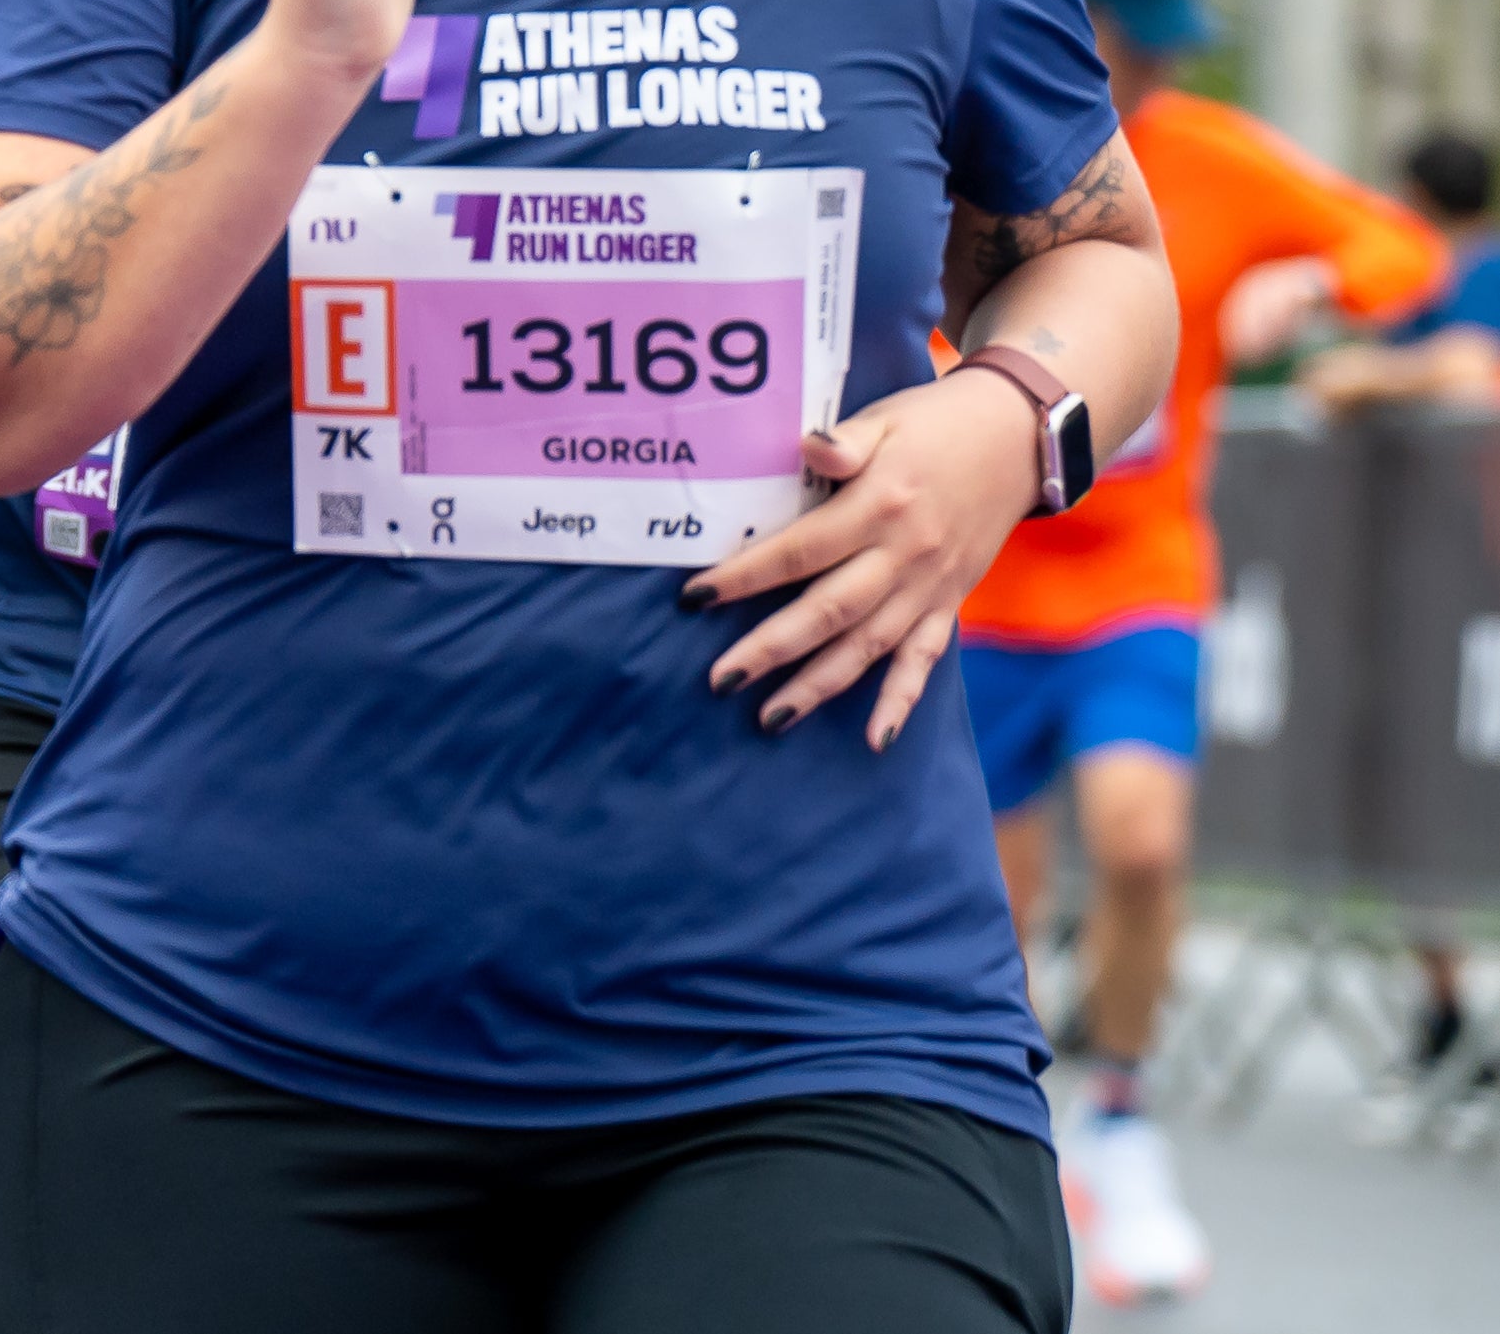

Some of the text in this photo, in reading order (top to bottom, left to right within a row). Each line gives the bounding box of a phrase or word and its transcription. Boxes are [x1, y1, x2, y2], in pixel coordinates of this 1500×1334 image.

[479, 5, 739, 73] ATHENAS
[480, 67, 826, 138] RUN LONGER
[507, 194, 647, 226] ATHENAS
[507, 233, 697, 264] RUN LONGER
[326, 301, 365, 396] E
[461, 318, 771, 396] 13169
[317, 427, 373, 461] 7K
[541, 437, 697, 465] GIORGIA
[522, 508, 597, 534] Jeep
